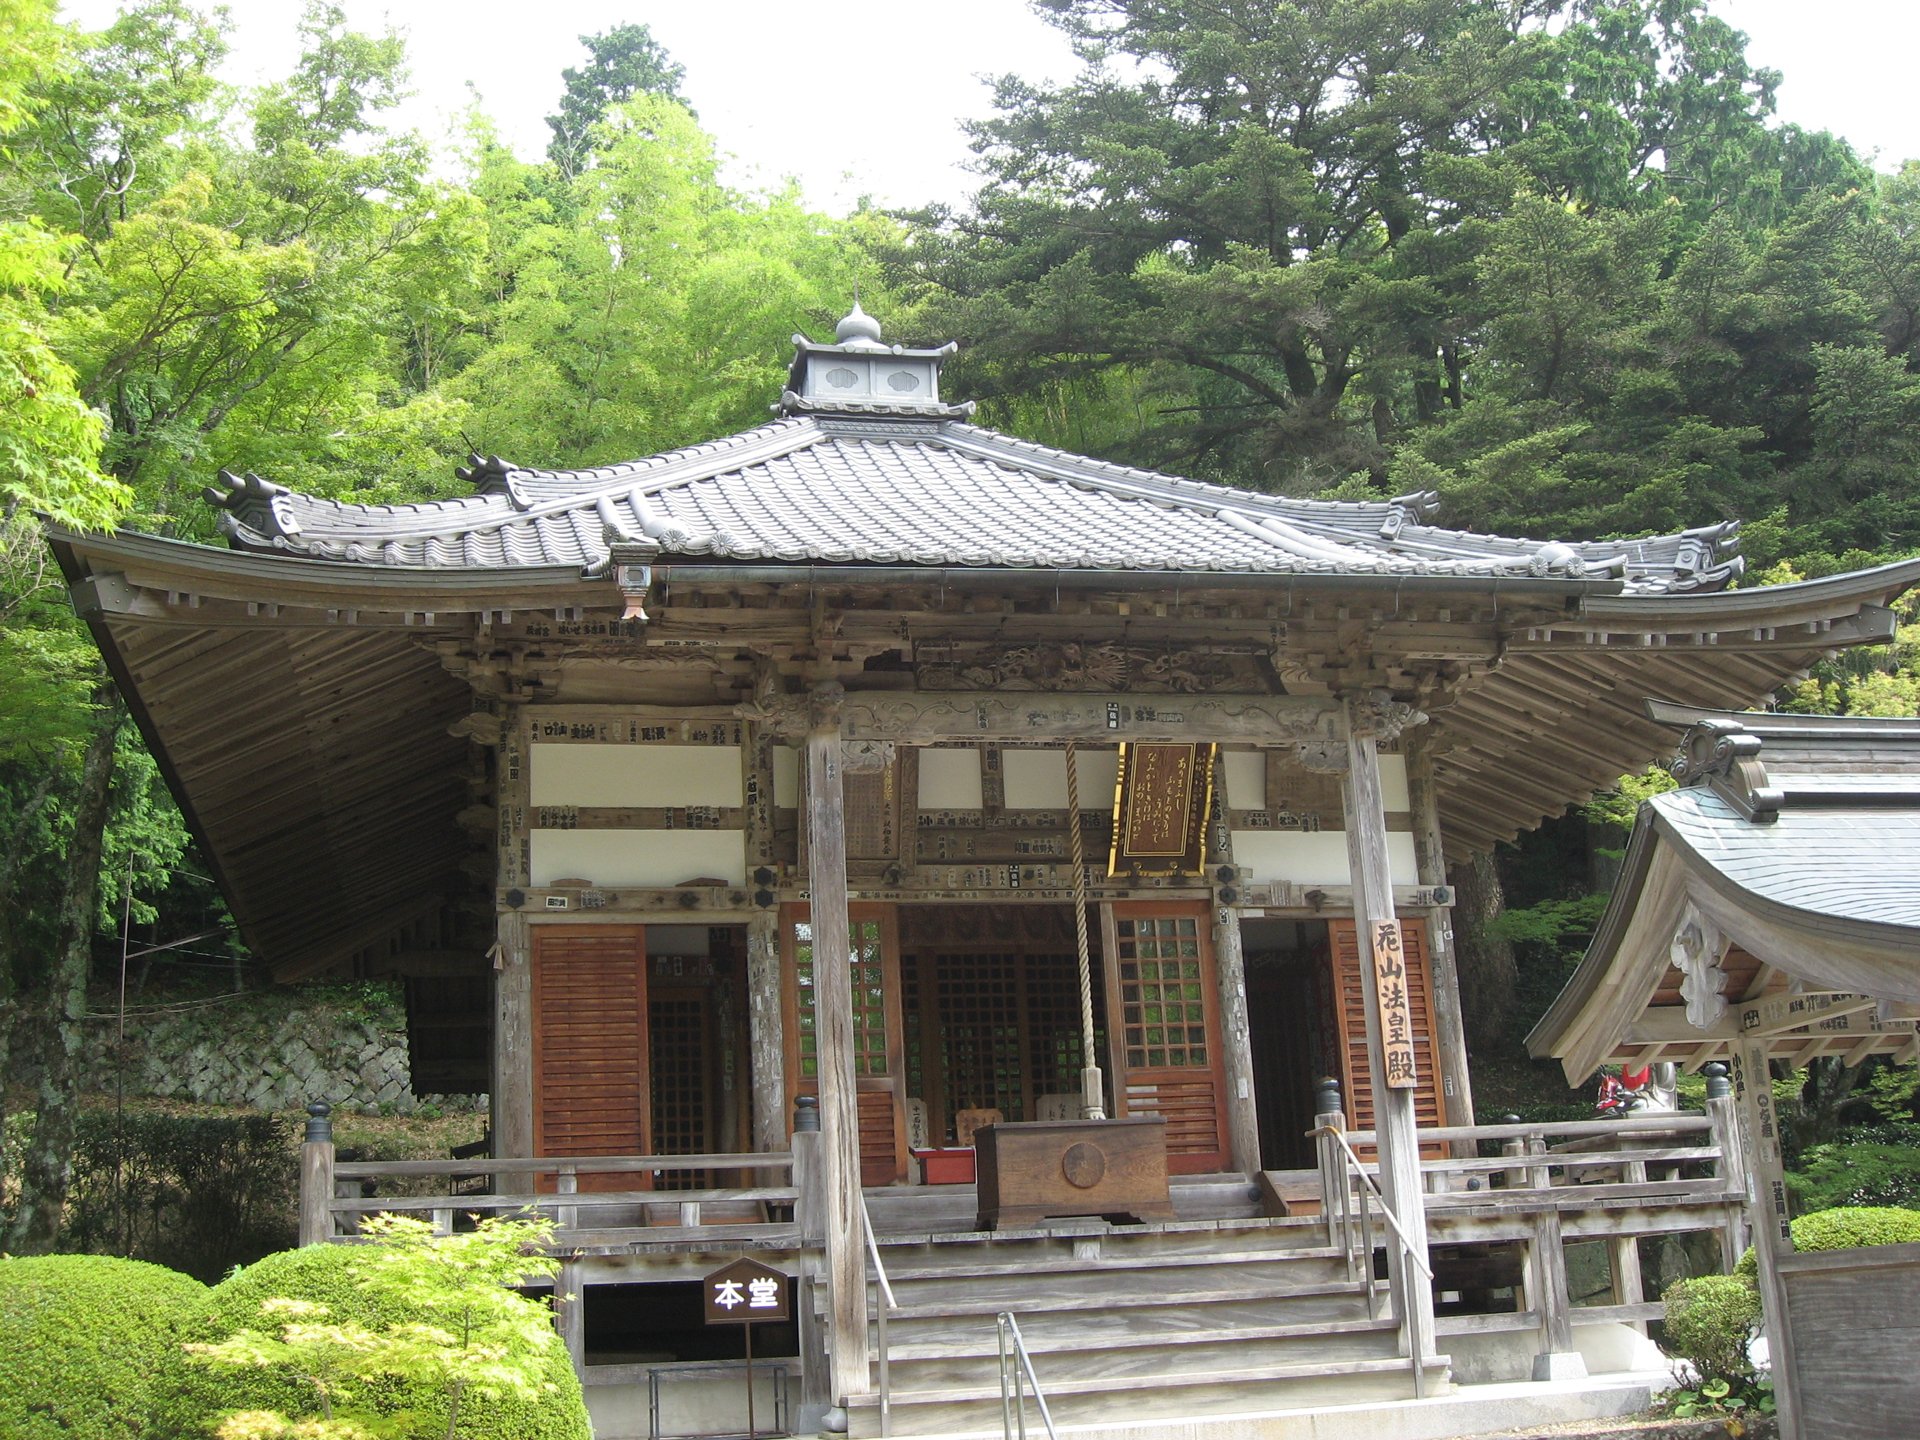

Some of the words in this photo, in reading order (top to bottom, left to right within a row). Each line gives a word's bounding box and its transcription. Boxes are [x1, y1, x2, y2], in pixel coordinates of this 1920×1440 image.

[1375, 923, 1416, 1081] 花山法皇殿
[714, 1277, 778, 1310] 本堂
